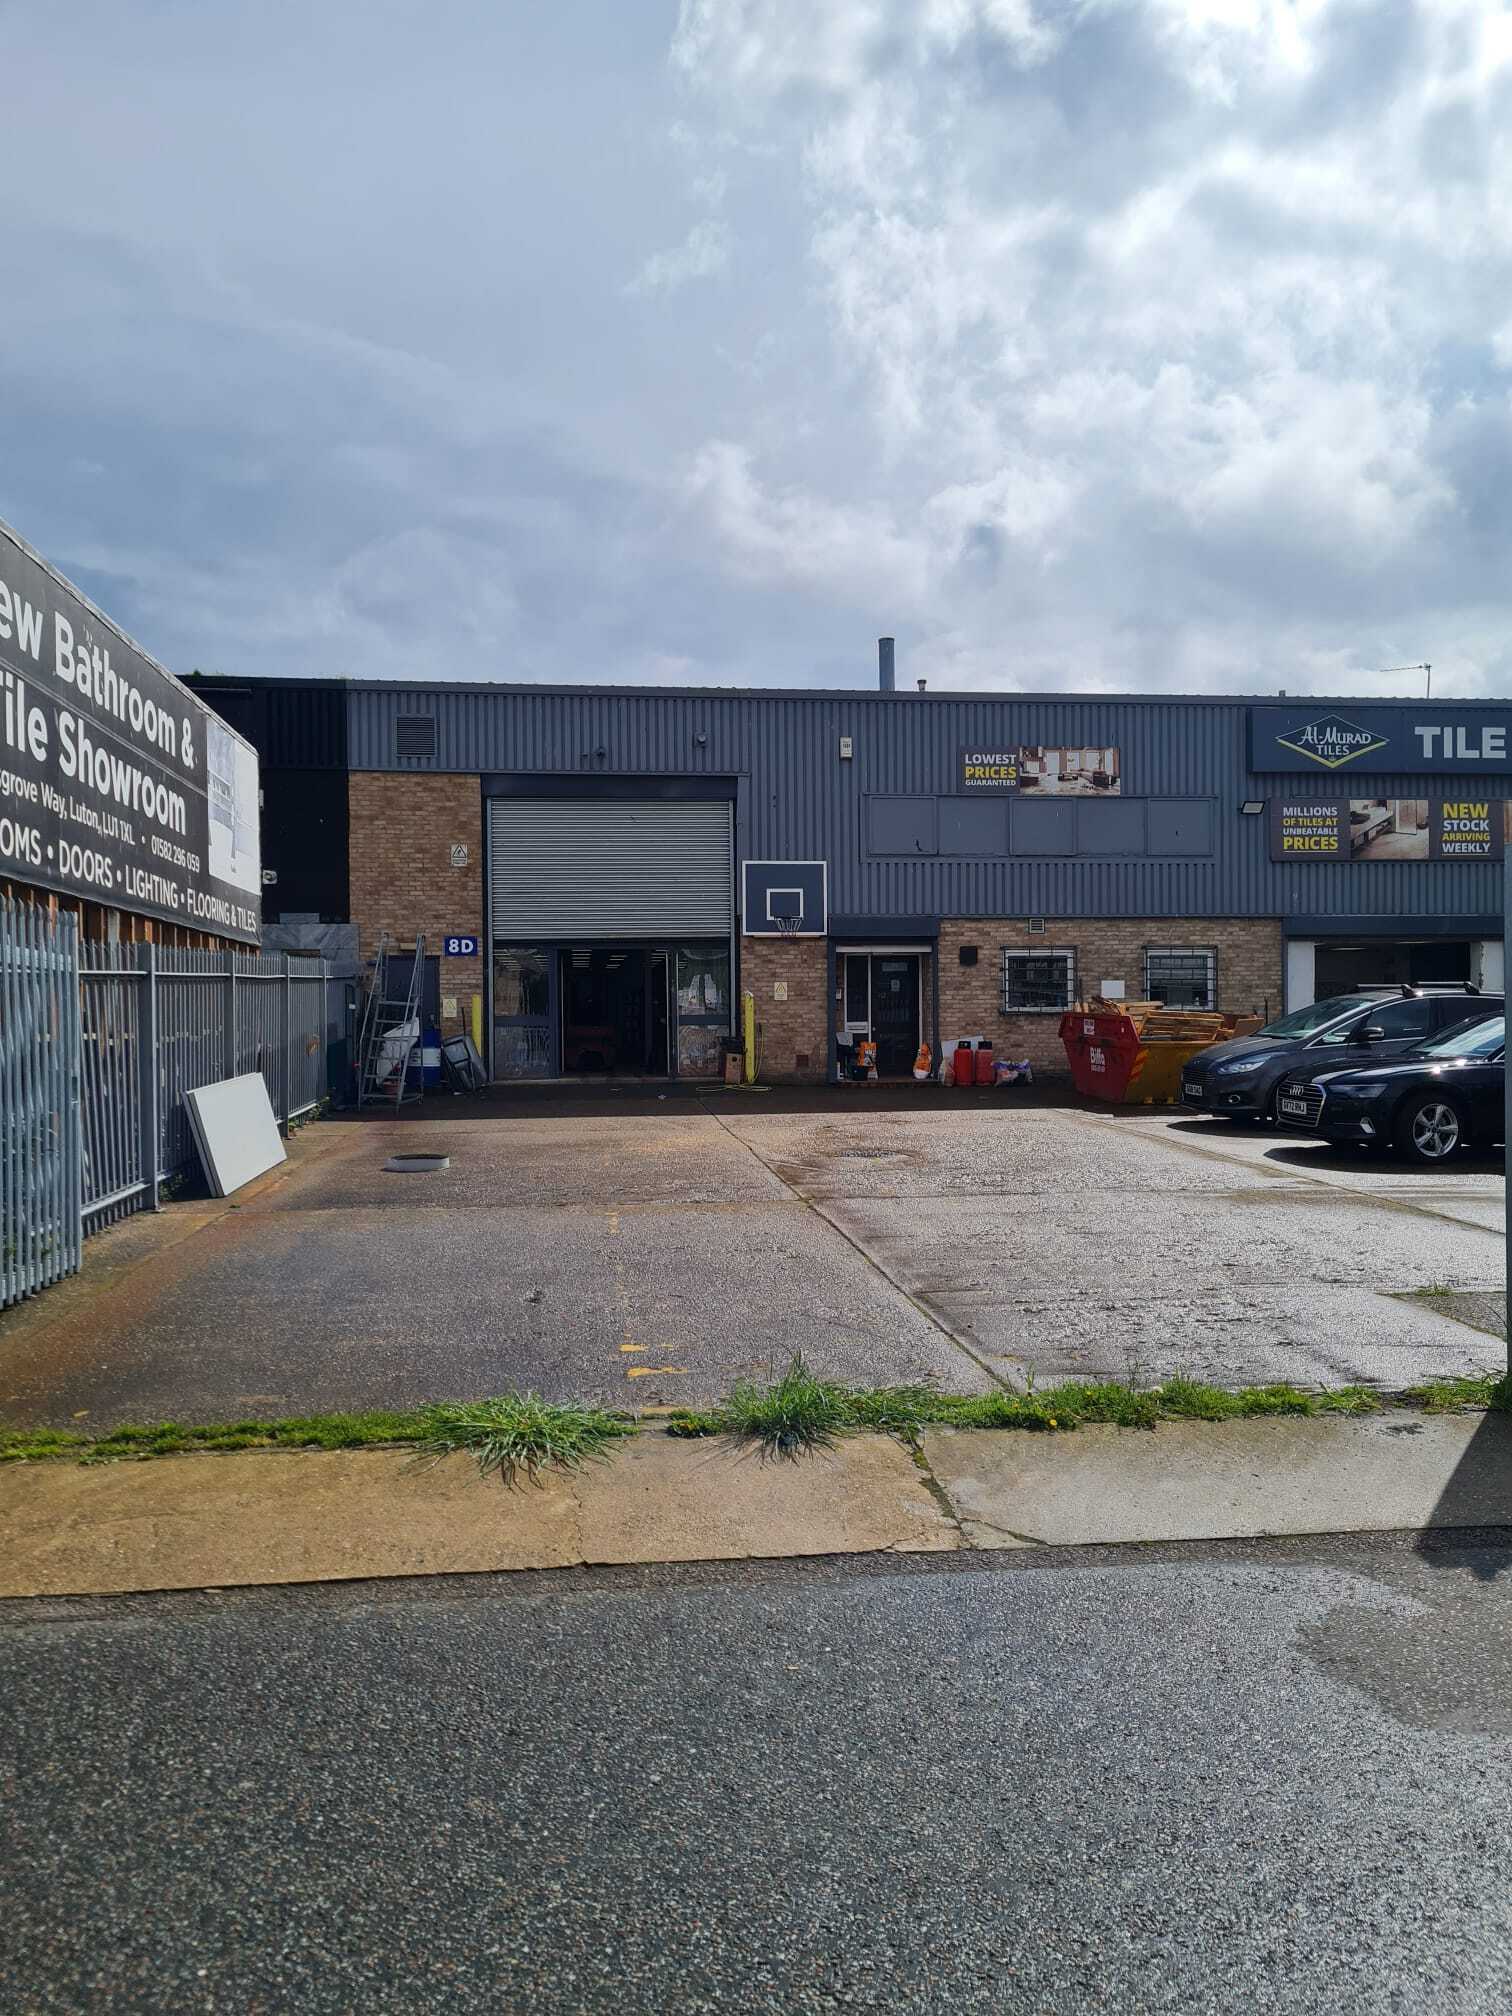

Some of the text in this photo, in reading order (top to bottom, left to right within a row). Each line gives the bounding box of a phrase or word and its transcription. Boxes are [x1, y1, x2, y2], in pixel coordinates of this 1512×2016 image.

[55, 611, 177, 757] Bathroom
[181, 717, 195, 769] &
[1414, 726, 1507, 759] TILE
[0, 670, 187, 836] ile Showroom
[1317, 745, 1350, 755] TILES
[965, 753, 1017, 764] LOWEST
[965, 767, 1017, 778] PRICES
[1283, 807, 1338, 816] MILLIONS
[1443, 803, 1489, 818] NEW
[0, 768, 38, 802] grove
[40, 781, 67, 820] Way,
[70, 796, 102, 837] Luton,
[151, 834, 173, 861] 01582
[186, 852, 200, 873] 059
[1283, 818, 1338, 826] OF TILES AT
[1443, 820, 1489, 831] STOCK
[1442, 833, 1490, 841] ARRIVING
[1283, 837, 1338, 849] PRICES
[1442, 843, 1490, 853] WEEKLY
[59, 840, 113, 888] DOORS
[126, 864, 178, 909] LIGHTING
[187, 888, 230, 925] FLOORING
[237, 906, 256, 932] TILES
[448, 939, 474, 953] 8D
